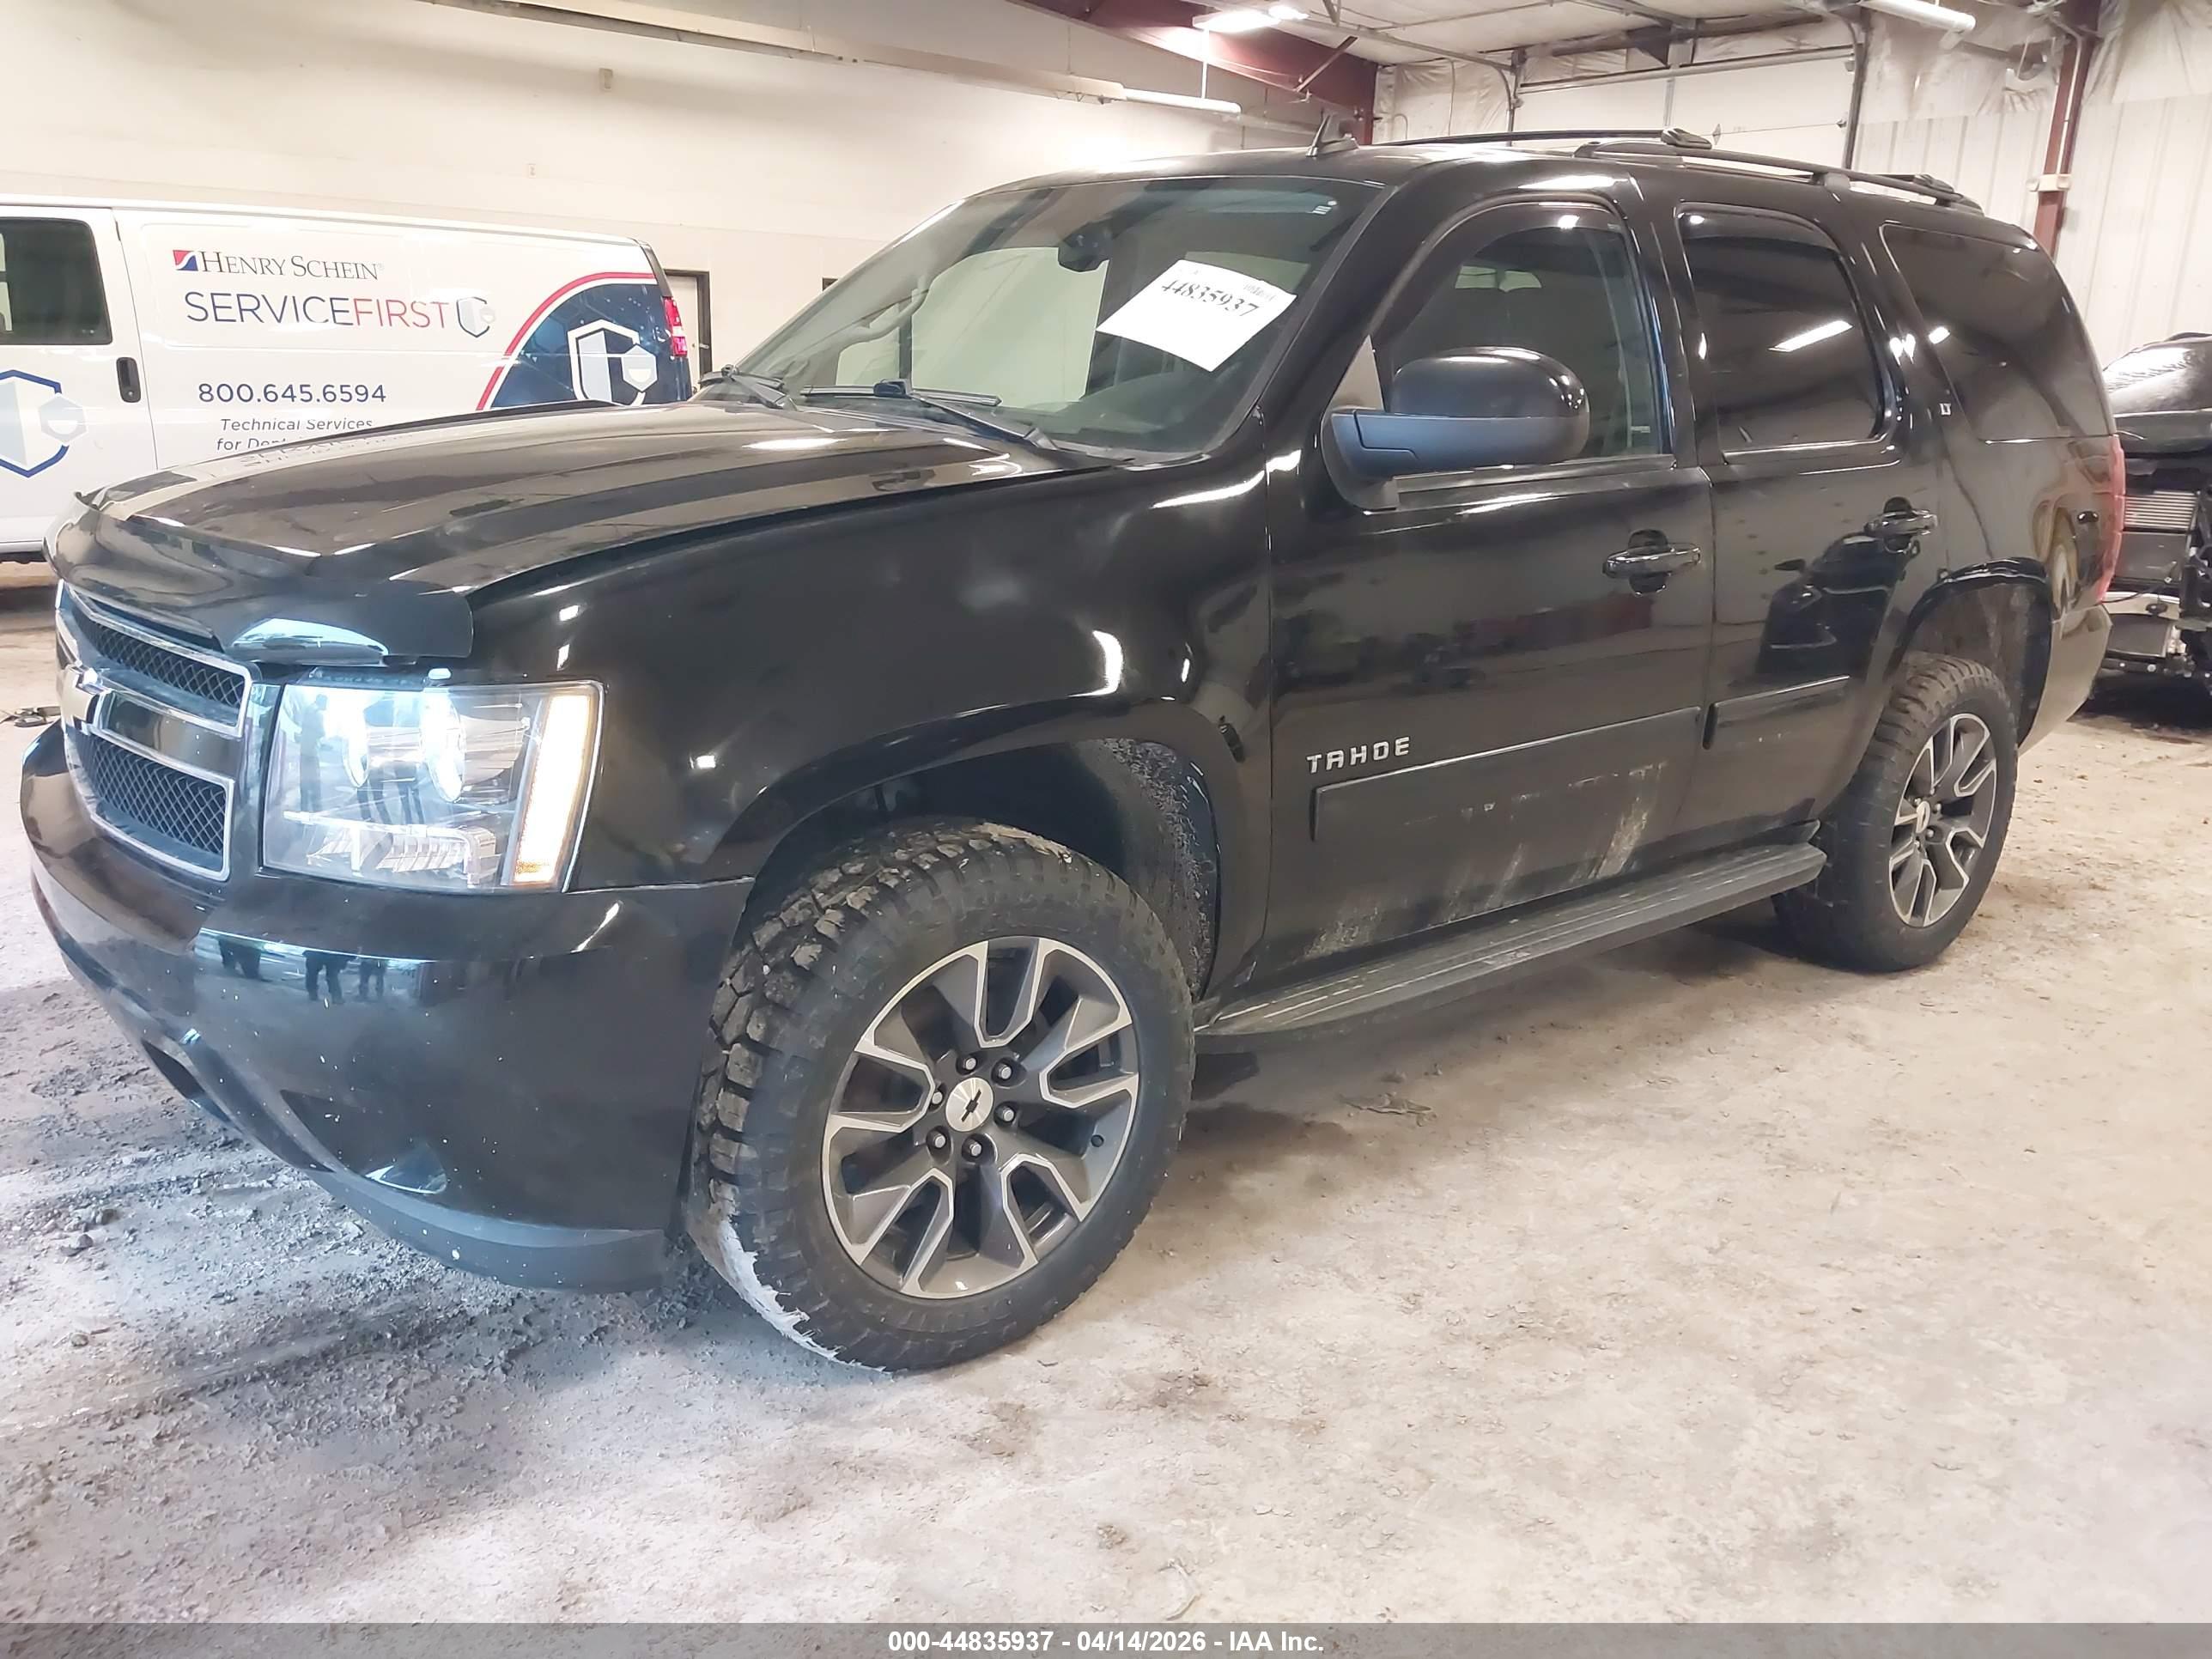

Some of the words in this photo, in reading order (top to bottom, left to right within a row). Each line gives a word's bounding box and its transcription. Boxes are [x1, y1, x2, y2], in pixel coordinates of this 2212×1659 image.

[185, 291, 449, 328] SERVICEFIRST
[1162, 280, 1259, 316] 44835937
[198, 383, 386, 403] 800.645.6594
[221, 418, 301, 431] Technical
[306, 417, 373, 430] Services
[216, 438, 241, 451] for
[1306, 737, 1410, 774] TAHOE
